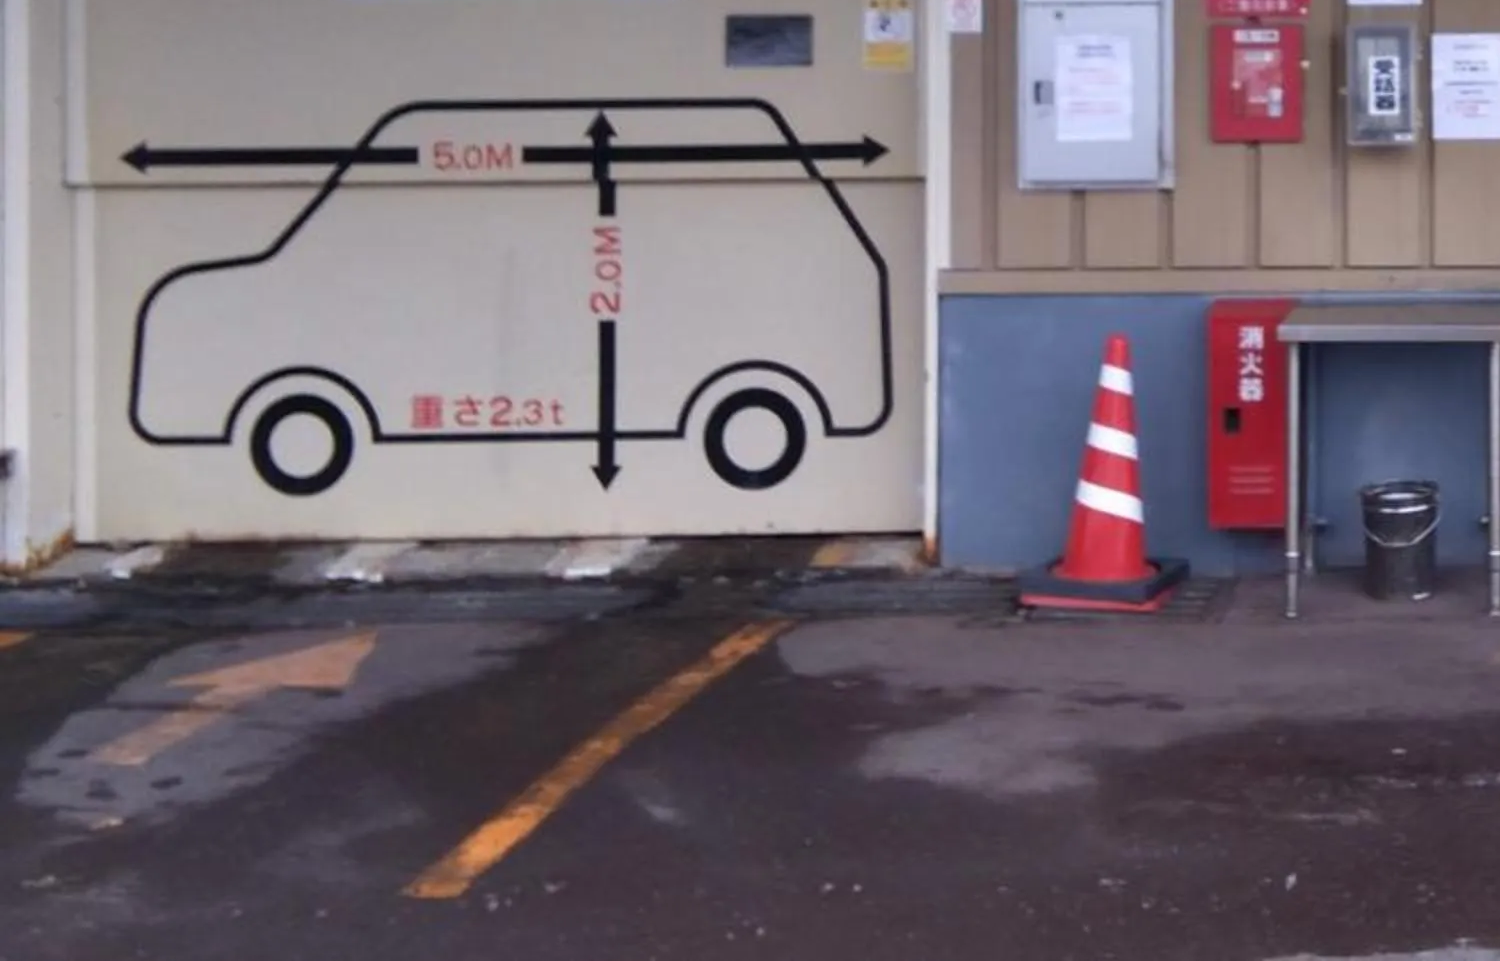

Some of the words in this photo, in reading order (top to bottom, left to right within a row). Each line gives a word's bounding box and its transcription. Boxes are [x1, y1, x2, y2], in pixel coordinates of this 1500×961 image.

[433, 140, 514, 170] 5.0M
[591, 225, 622, 314] 2.0M
[1238, 325, 1265, 402] 消火器
